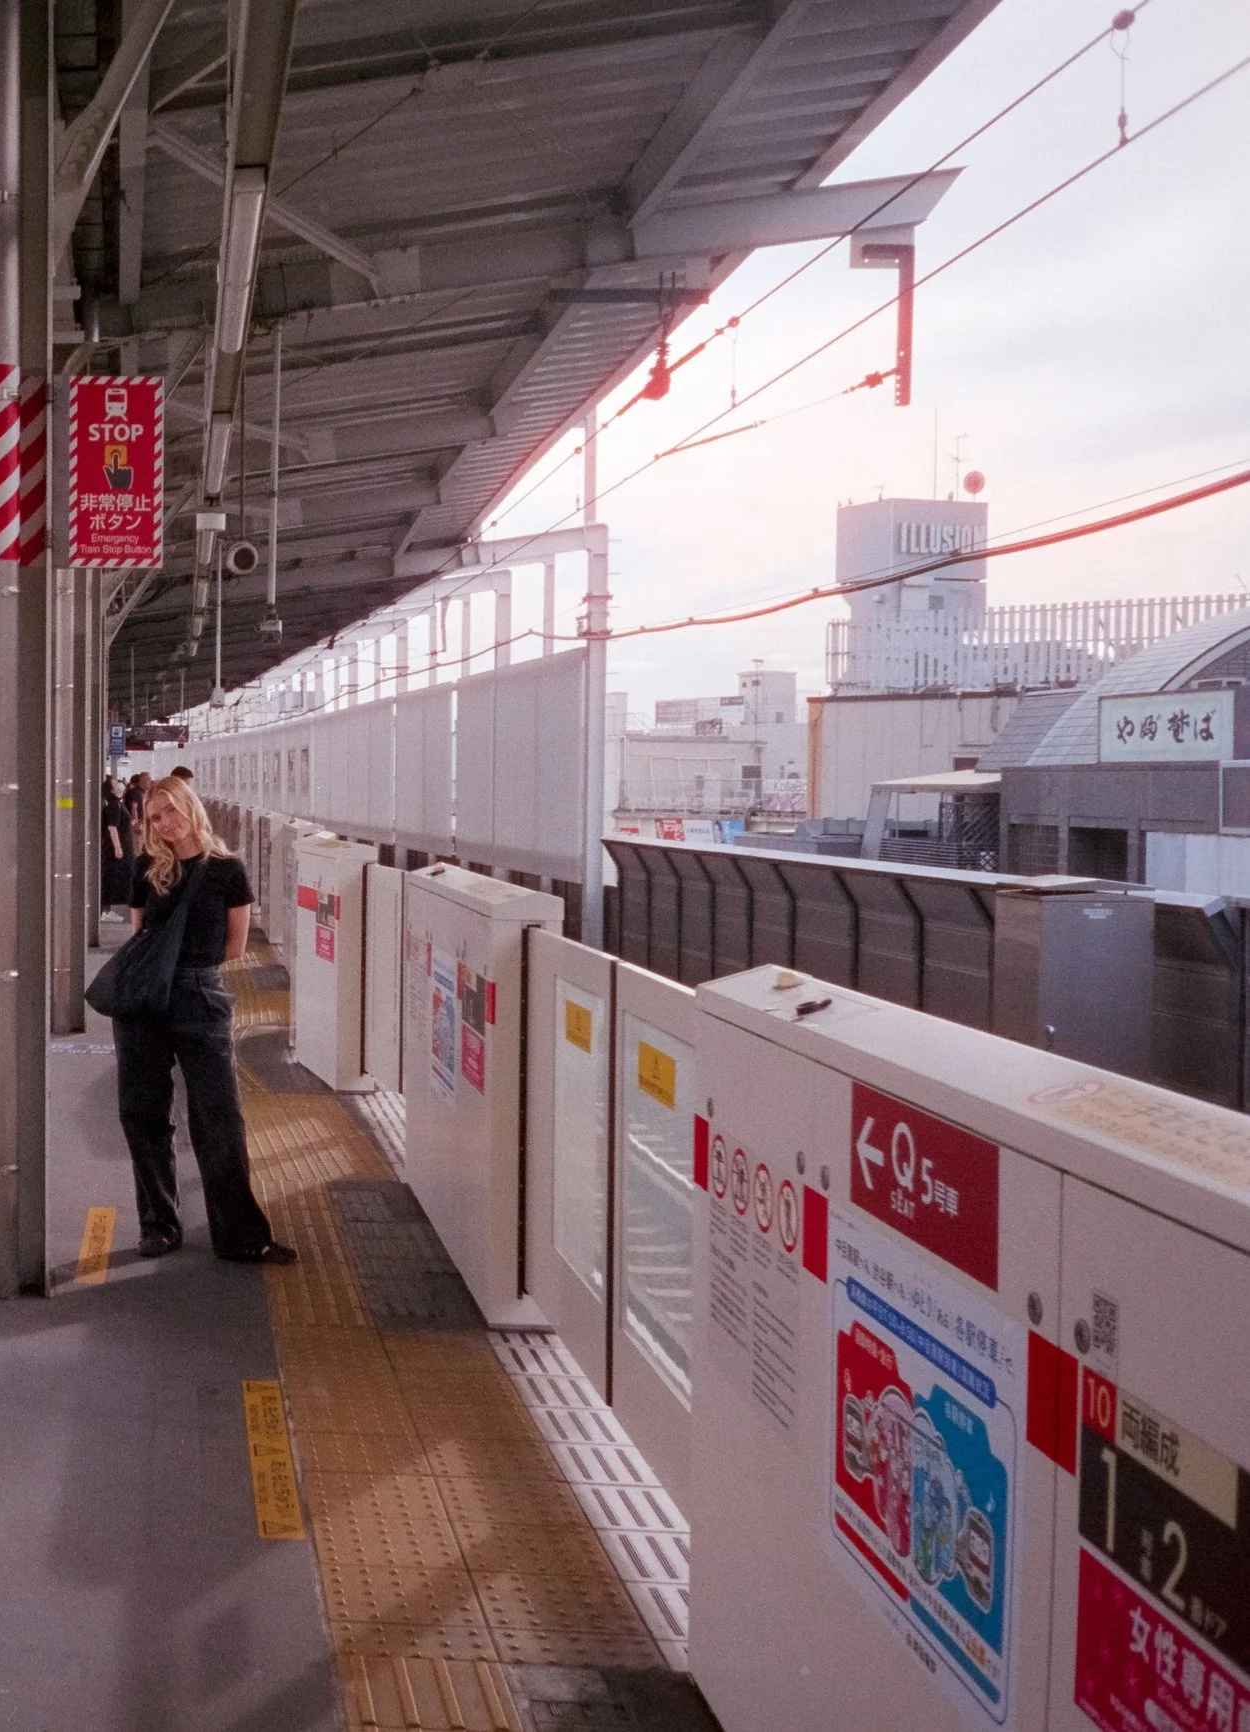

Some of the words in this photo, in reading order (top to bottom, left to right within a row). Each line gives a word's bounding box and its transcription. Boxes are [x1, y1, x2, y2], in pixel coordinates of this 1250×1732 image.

[88, 423, 144, 442] STOP
[80, 493, 151, 512] 非常停止
[89, 513, 141, 531] ボタン
[80, 544, 101, 554] Train
[102, 544, 122, 555] Stop
[124, 544, 152, 554] Button
[91, 533, 140, 544] Emergency
[900, 521, 986, 554] ILLUSION
[891, 1121, 915, 1192] Q
[920, 1157, 960, 1218] 5号車
[889, 1187, 916, 1220] SEAT
[1087, 1376, 1111, 1429] 10
[1120, 1400, 1181, 1478] 両編成
[1100, 1447, 1118, 1553] 1
[1161, 1519, 1188, 1611] 2
